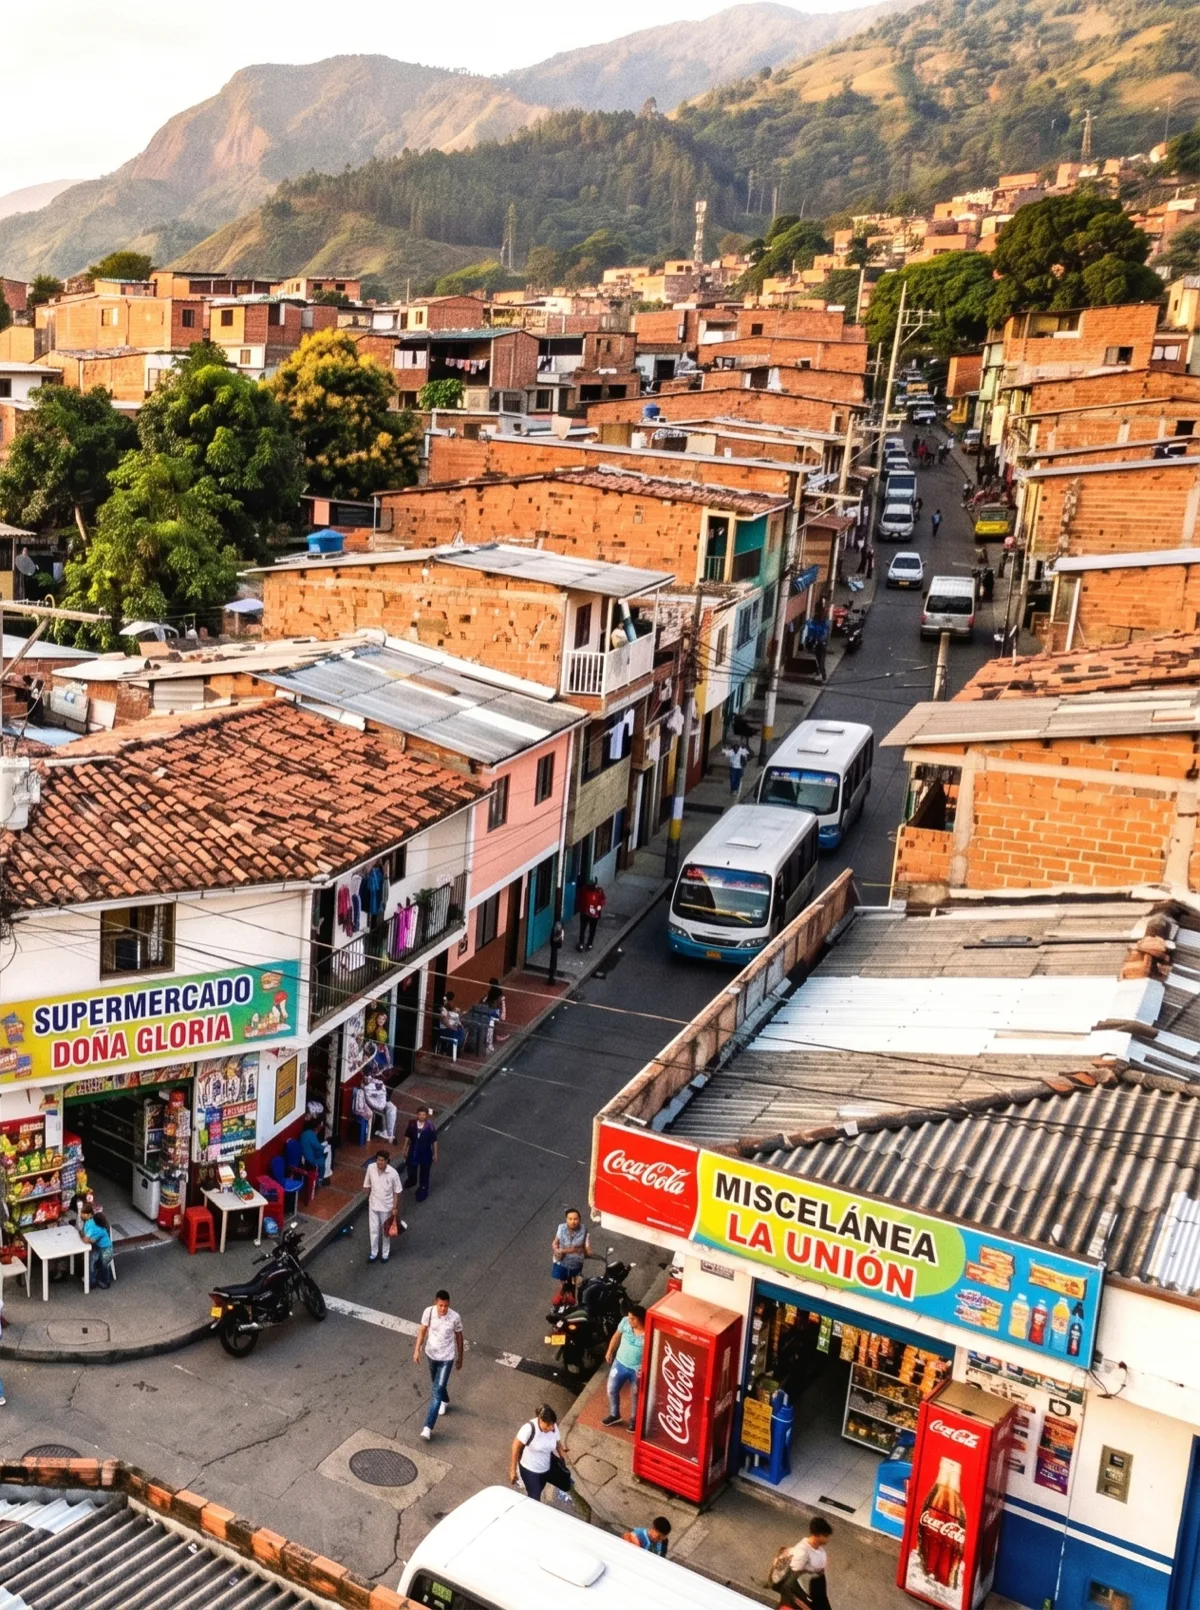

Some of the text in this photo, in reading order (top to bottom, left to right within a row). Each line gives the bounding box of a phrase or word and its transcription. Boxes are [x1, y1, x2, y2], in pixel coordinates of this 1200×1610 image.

[34, 976, 251, 1034] SUPERMERCADO
[53, 1029, 128, 1068] DOÑA
[137, 1015, 231, 1052] GLORIA
[715, 1172, 937, 1264] MISCELÁNEA
[728, 1213, 915, 1299] LA UNIÓN
